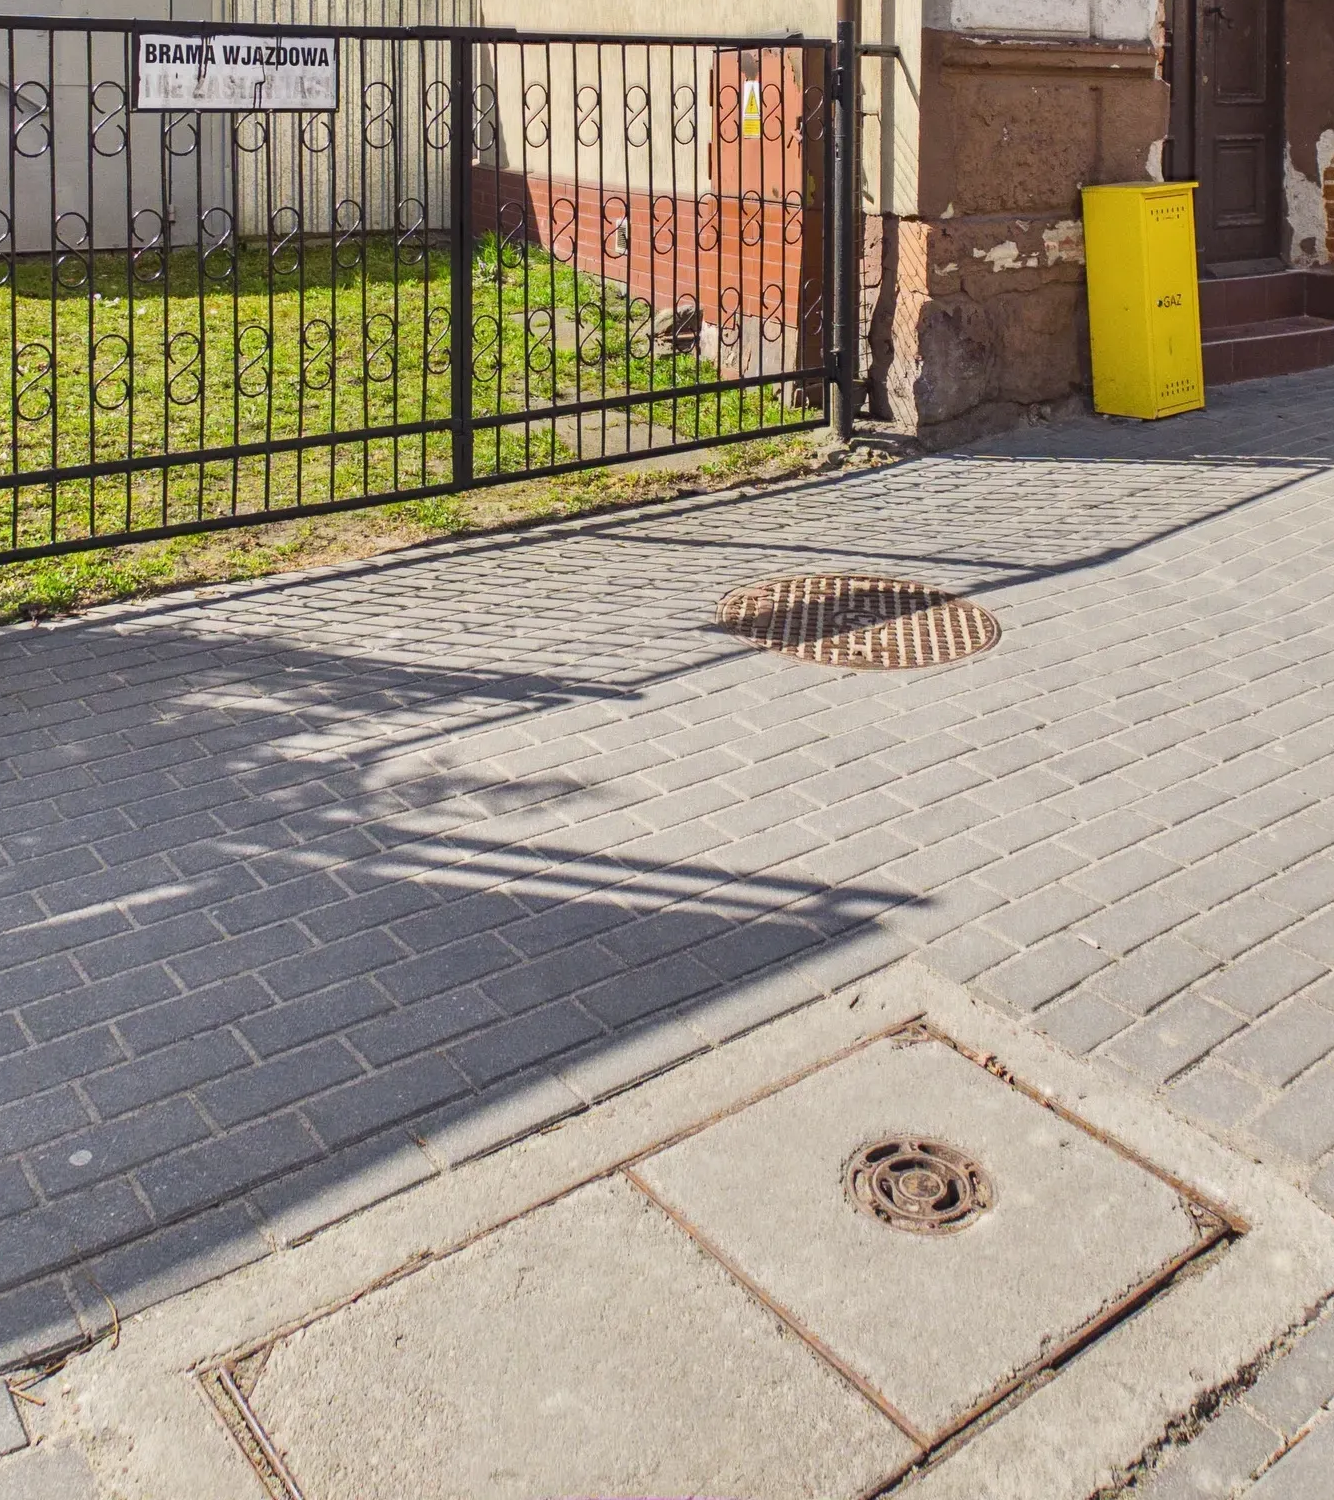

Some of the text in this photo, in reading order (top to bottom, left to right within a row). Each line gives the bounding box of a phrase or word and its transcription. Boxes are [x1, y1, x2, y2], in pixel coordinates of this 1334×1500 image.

[145, 43, 330, 67] BRAMA WJAZDOWA
[1163, 293, 1182, 308] GAZ
